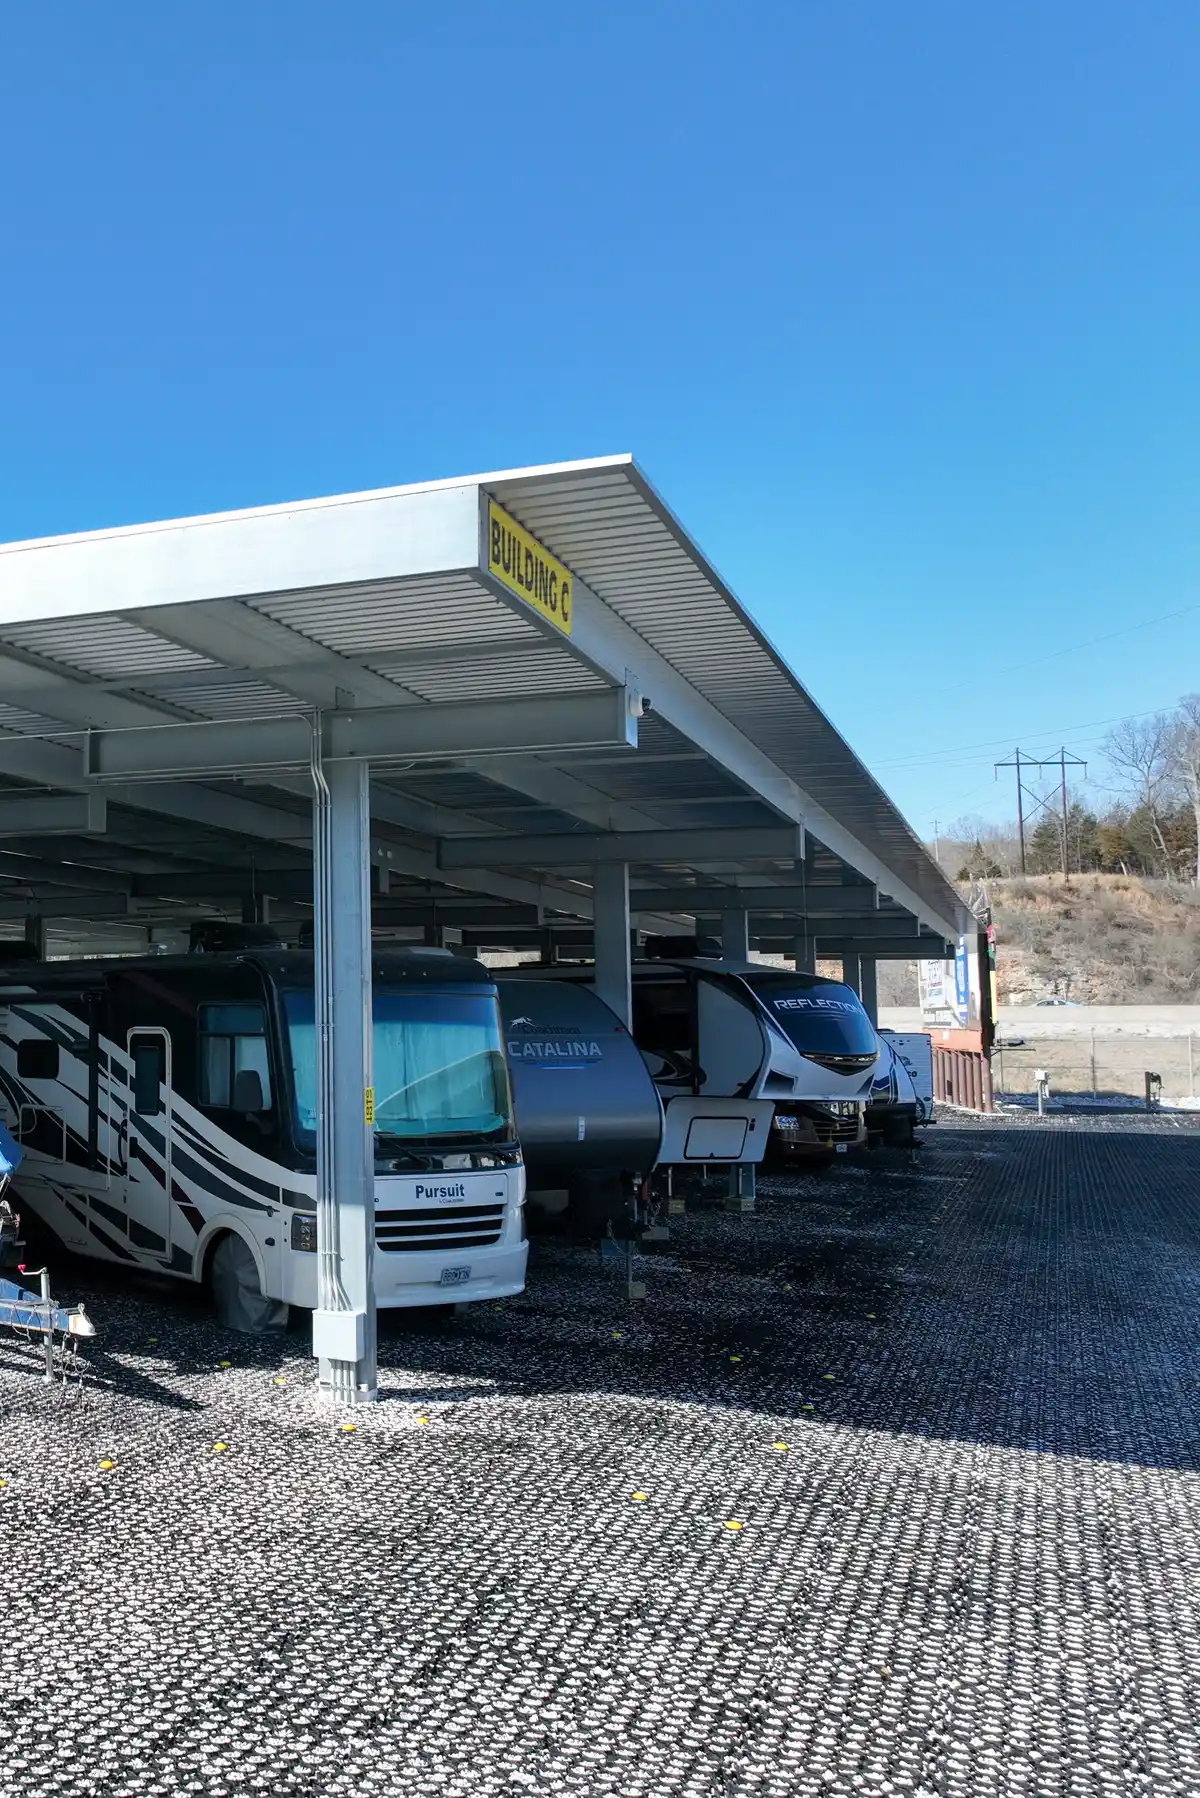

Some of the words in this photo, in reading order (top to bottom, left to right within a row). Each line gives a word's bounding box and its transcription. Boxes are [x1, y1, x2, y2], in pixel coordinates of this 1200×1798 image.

[490, 516, 558, 613] BUILDING
[560, 579, 570, 623] C
[773, 998, 865, 1017] REFLECTION
[507, 1041, 603, 1057] CATALINA
[415, 1183, 465, 1199] Pursuit
